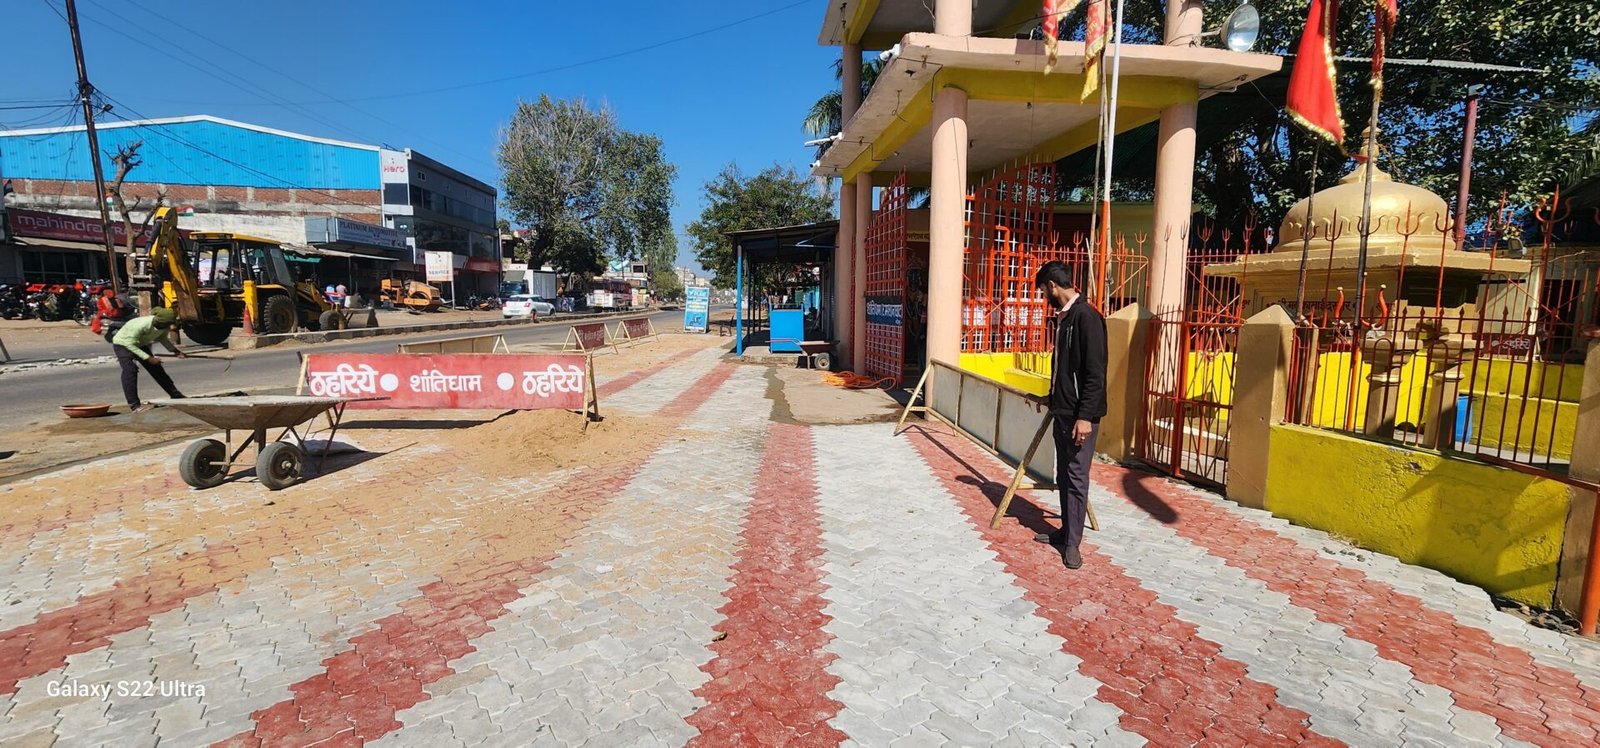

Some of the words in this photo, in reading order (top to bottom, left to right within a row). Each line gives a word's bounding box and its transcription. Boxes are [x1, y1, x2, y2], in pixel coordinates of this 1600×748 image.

[17, 215, 104, 233] mahindra
[310, 363, 378, 397] ठहरिये
[409, 368, 482, 393] शांतिधाम
[522, 363, 585, 397] ठहरिये
